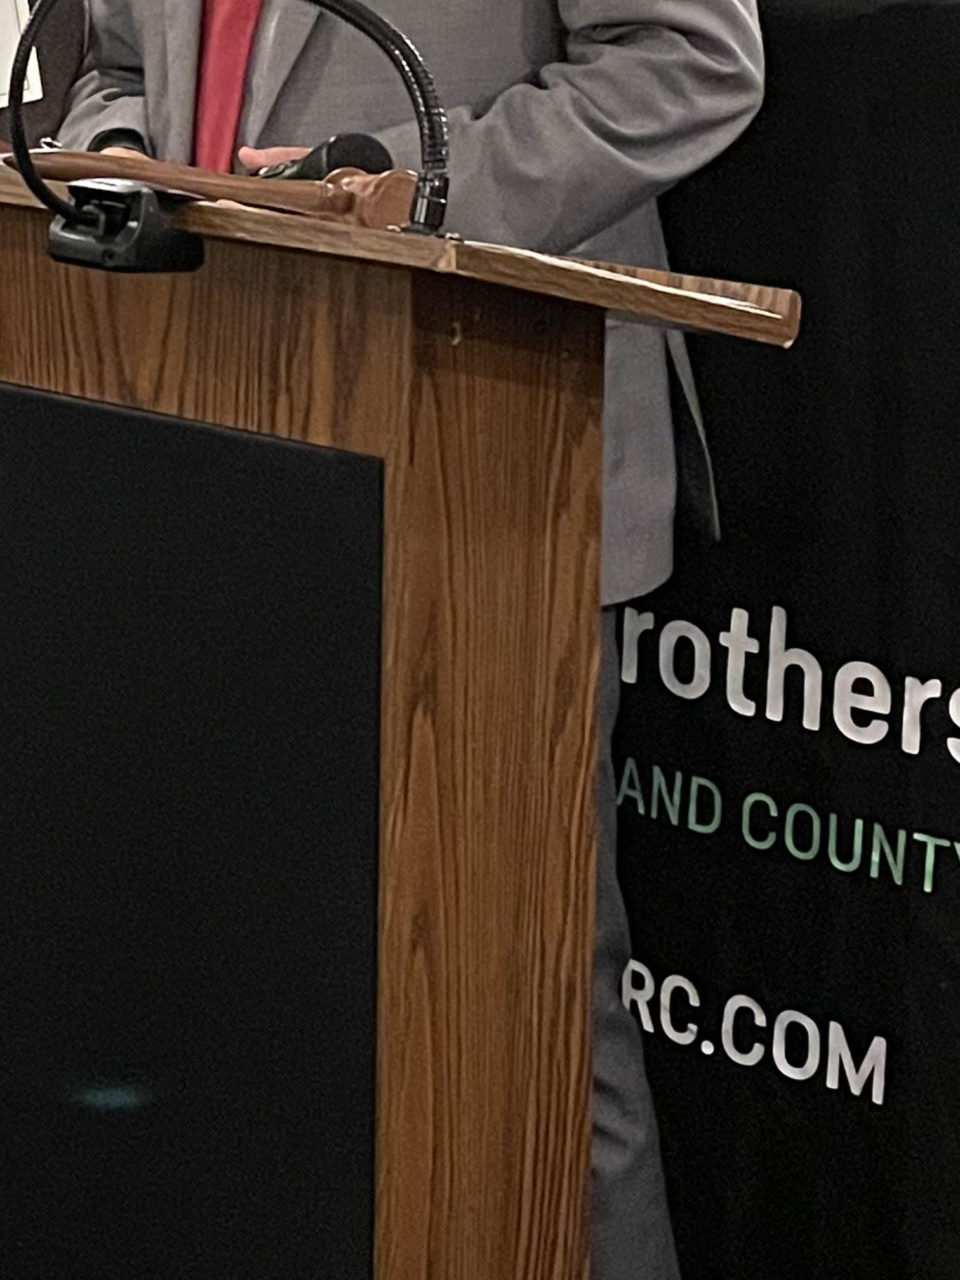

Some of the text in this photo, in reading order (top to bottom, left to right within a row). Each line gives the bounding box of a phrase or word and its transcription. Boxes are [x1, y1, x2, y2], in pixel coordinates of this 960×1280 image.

[621, 605, 960, 764] rother
[742, 792, 960, 893] COUNT
[622, 958, 888, 1106] RC.COM
